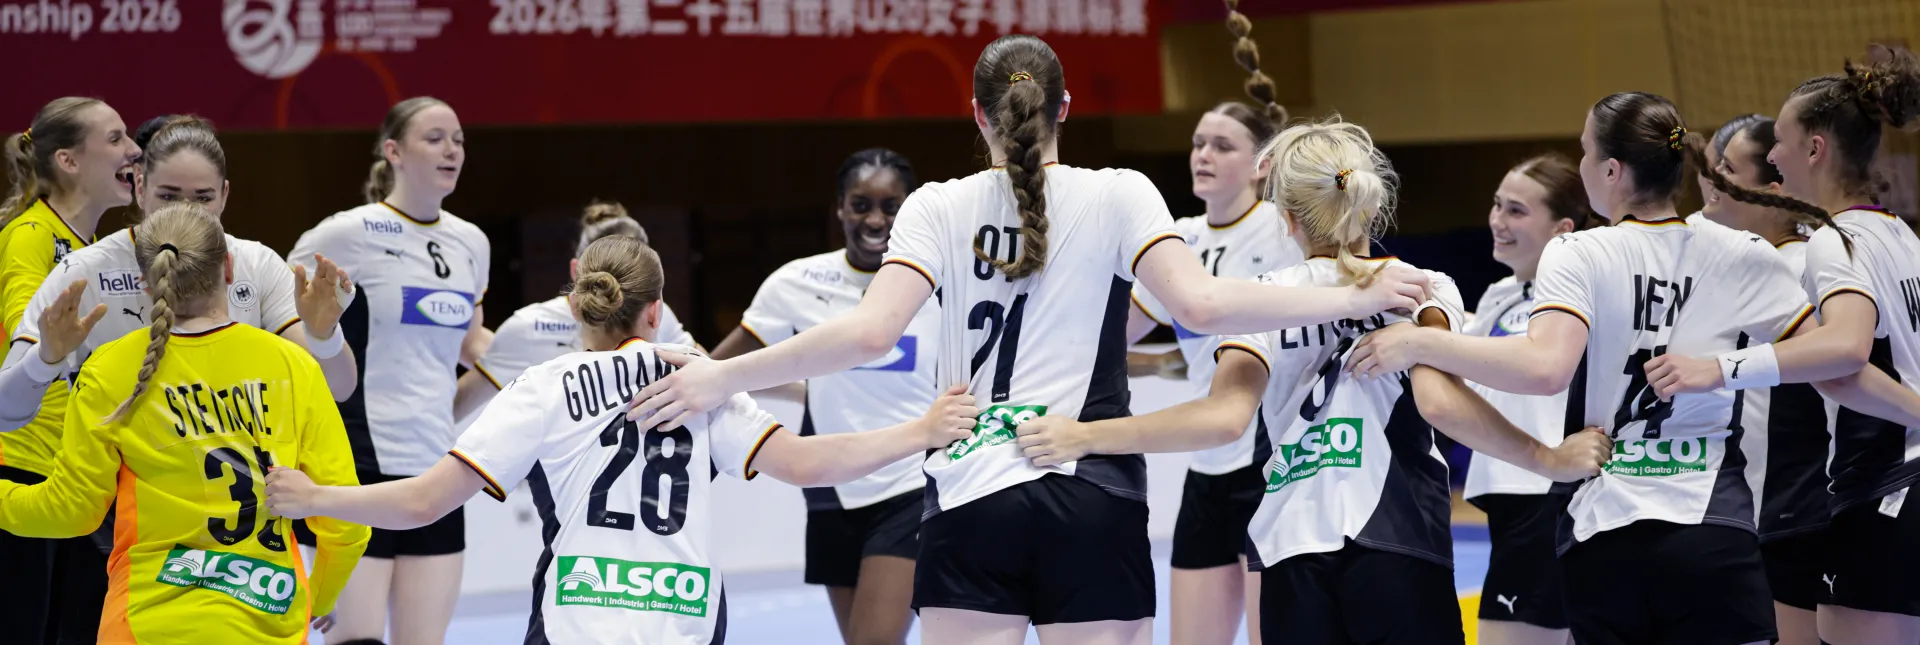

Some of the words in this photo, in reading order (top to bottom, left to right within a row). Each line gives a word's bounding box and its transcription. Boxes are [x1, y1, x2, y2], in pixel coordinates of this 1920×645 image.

[1, 0, 93, 40] nship
[100, 0, 181, 33] 2026
[427, 241, 451, 279] 6
[1200, 246, 1227, 277] 17
[430, 301, 466, 317] TENA
[968, 292, 1029, 403] 21
[587, 412, 693, 536] 28
[1644, 466, 1672, 474] Gastro
[164, 549, 294, 601] ALSCO
[202, 579, 234, 594] Industrie
[239, 592, 264, 608] Gastro
[558, 556, 706, 601] ALSCO
[562, 595, 602, 605] Handwerk
[609, 597, 645, 609] Industrie
[680, 604, 702, 614] Hotel
